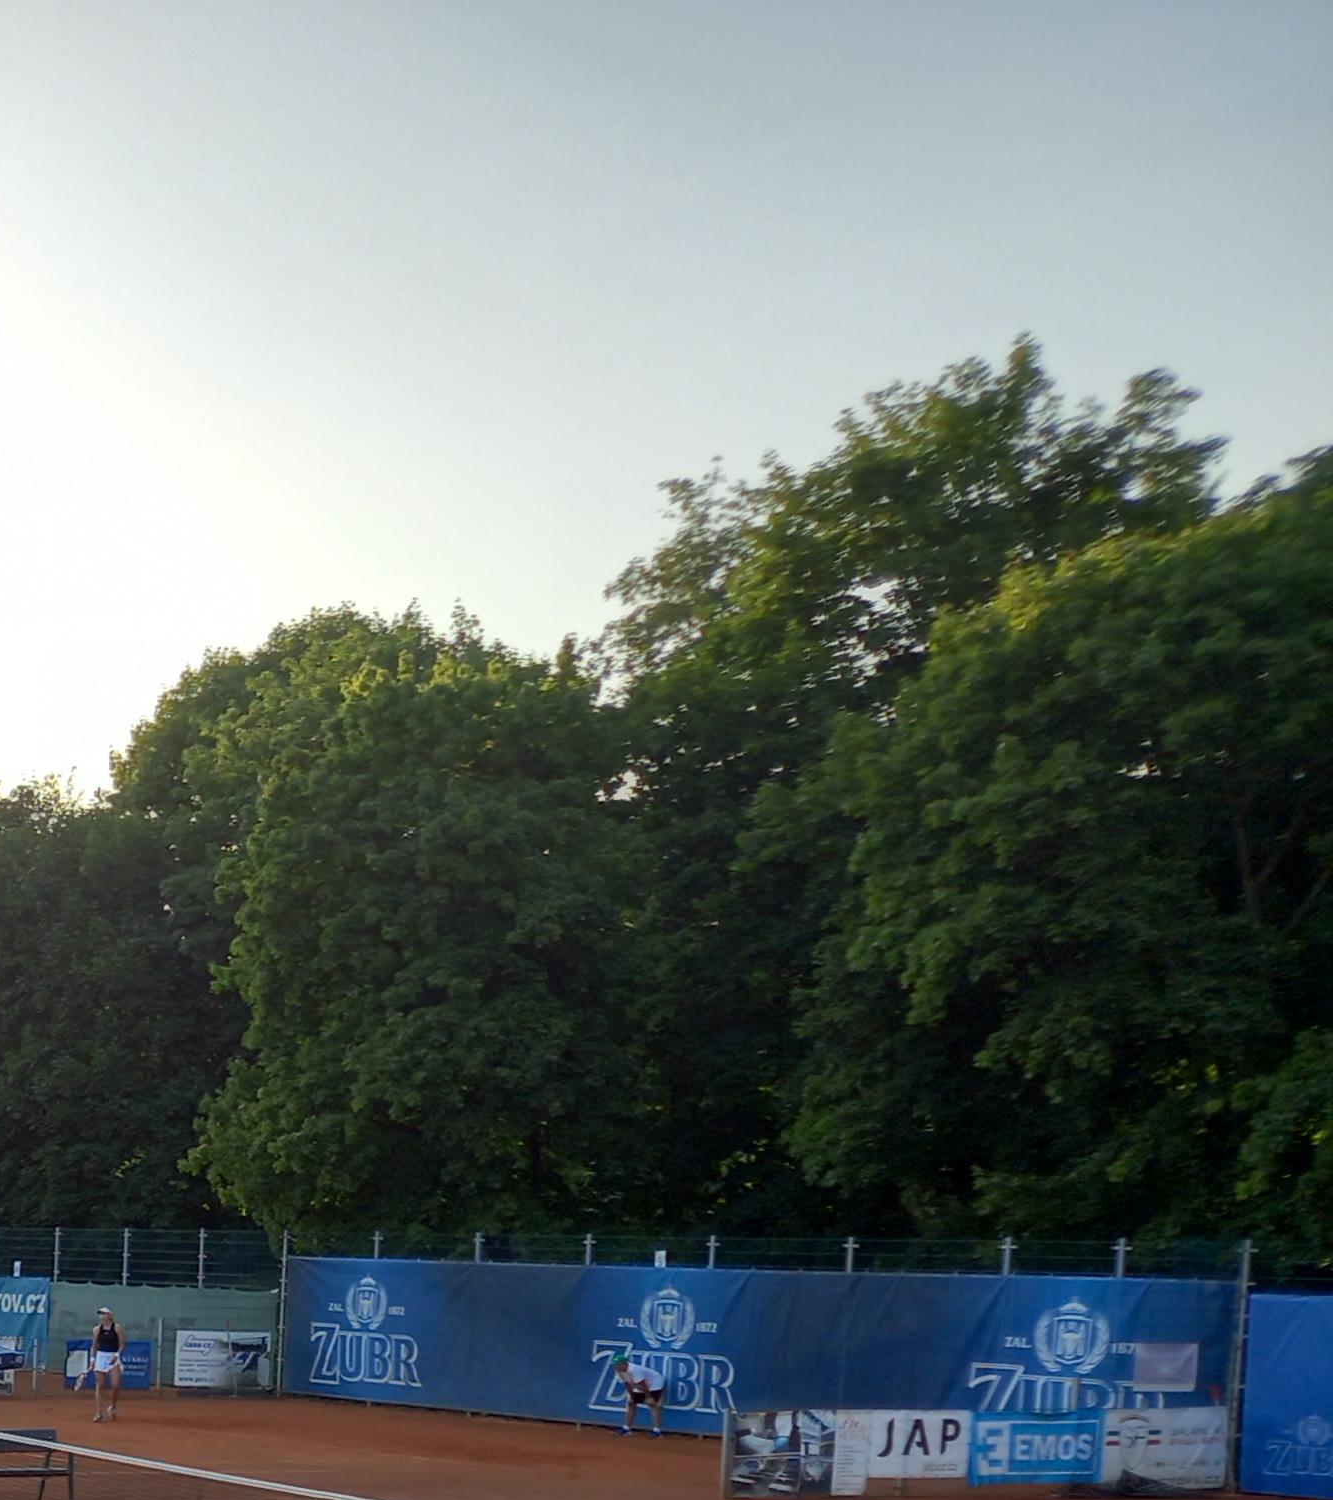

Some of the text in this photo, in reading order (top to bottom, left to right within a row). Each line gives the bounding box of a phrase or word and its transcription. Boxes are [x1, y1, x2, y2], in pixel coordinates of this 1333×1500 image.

[388, 1305, 405, 1316] 1872
[695, 1322, 717, 1333] 1872
[308, 1322, 422, 1387] ZUBR
[1112, 1342, 1139, 1355] 187
[589, 1339, 736, 1414] ZBR
[877, 1417, 961, 1458] JAP
[1016, 1432, 1093, 1462] EMOS
